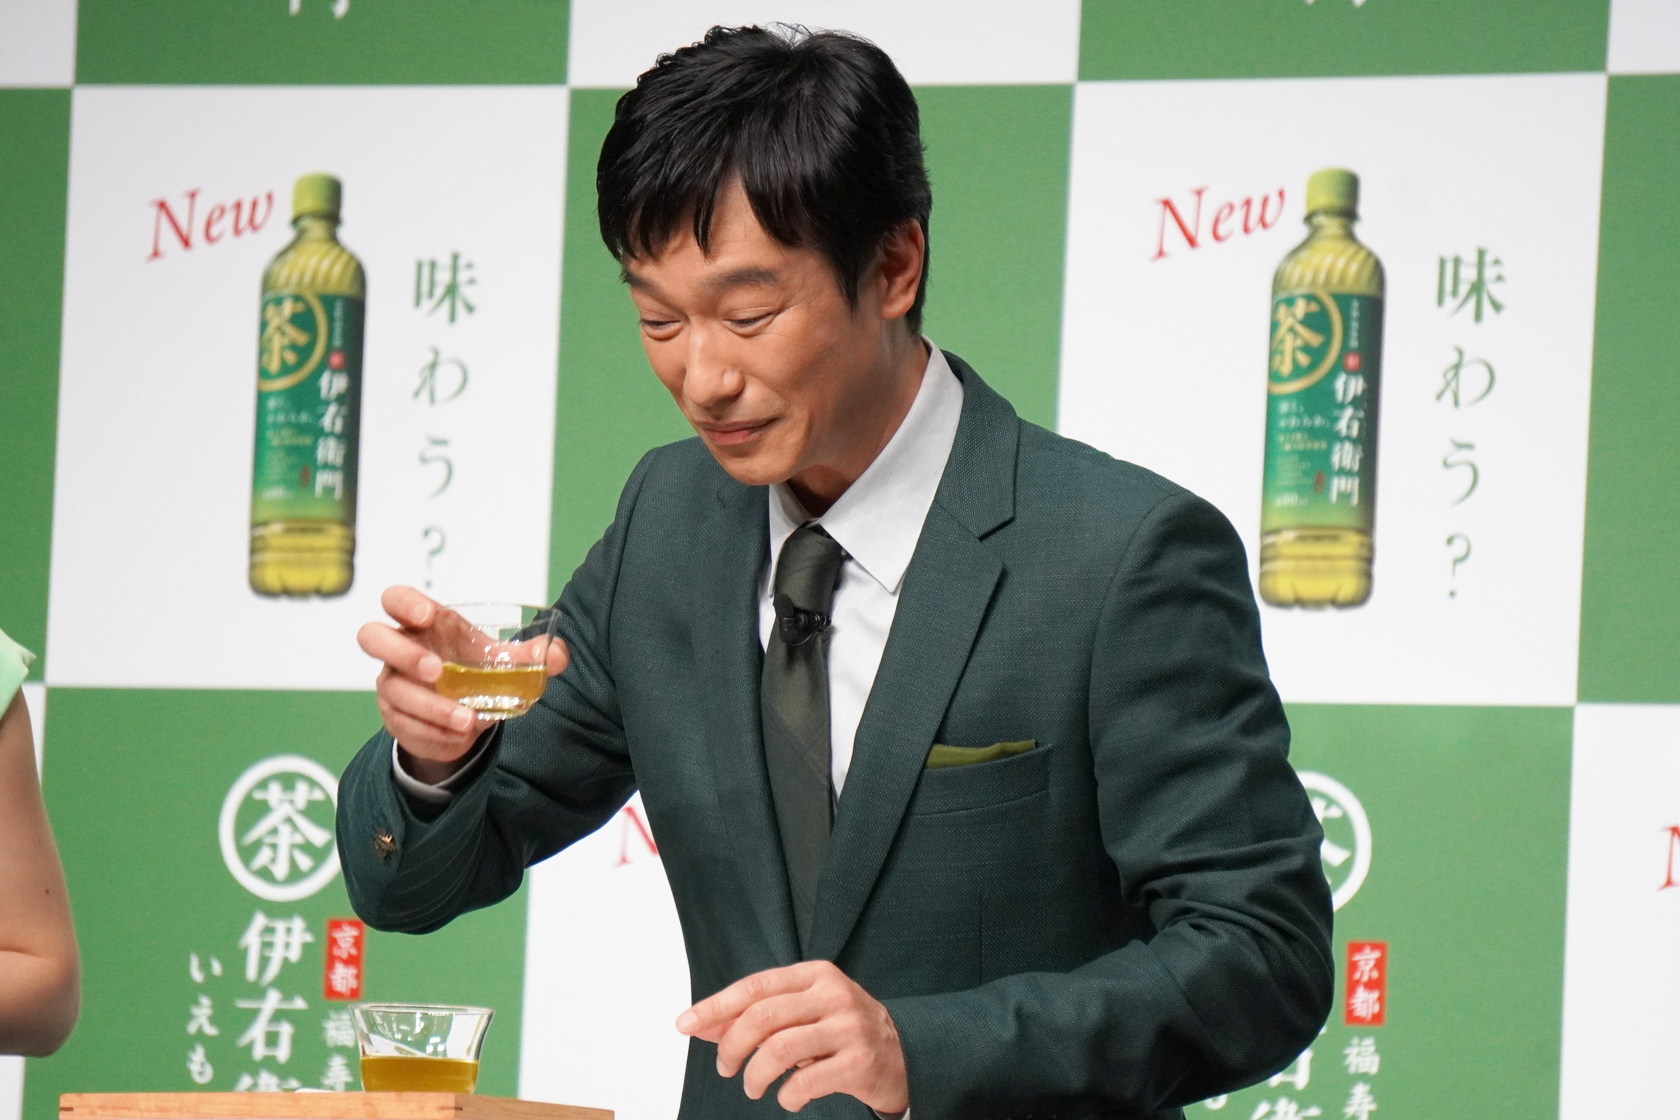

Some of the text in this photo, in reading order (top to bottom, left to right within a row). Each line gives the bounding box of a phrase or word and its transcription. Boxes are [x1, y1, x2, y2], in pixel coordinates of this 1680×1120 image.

[146, 187, 274, 261] New
[1151, 186, 1285, 262] New
[260, 297, 309, 374] 茶
[1270, 297, 1324, 377] 茶
[1329, 371, 1367, 507] 伊右衛門
[241, 780, 333, 882] 茶
